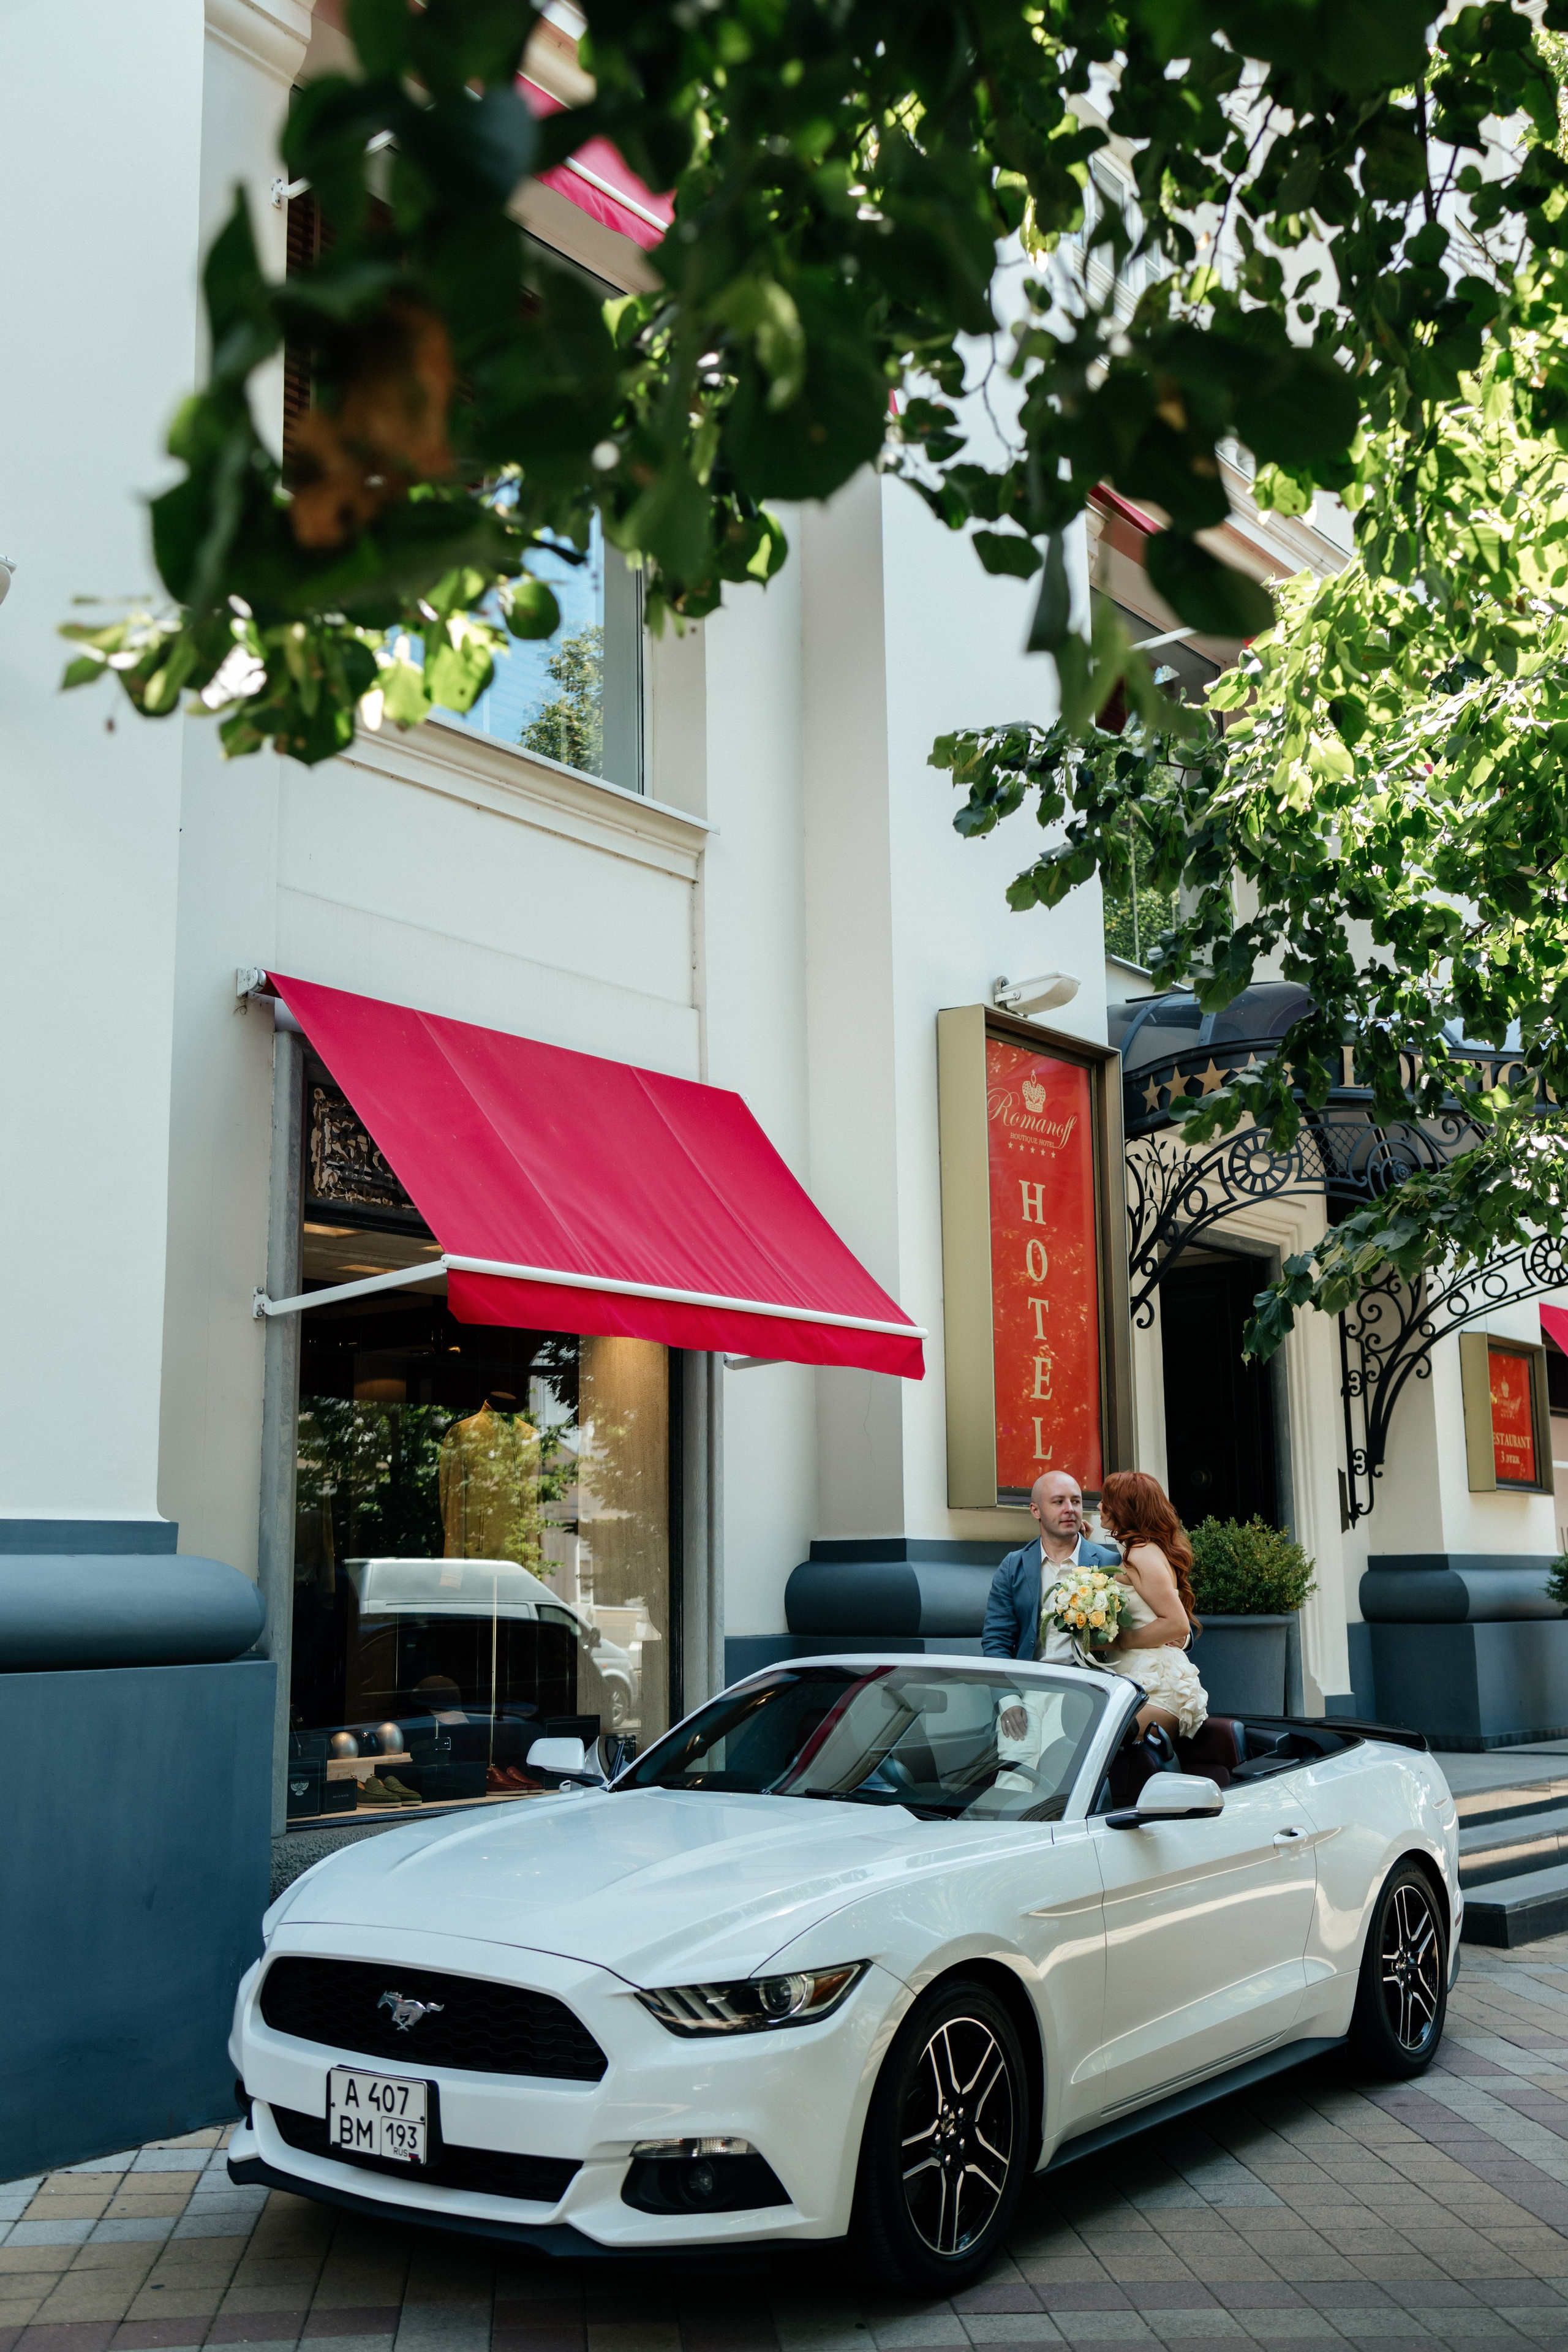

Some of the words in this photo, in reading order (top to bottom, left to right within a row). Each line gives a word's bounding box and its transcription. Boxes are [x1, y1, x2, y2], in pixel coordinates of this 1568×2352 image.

[987, 1088, 1077, 1149] Romanoff
[1010, 1133, 1038, 1144] BOUTIQUE
[1039, 1139, 1056, 1148] HOTEL
[1019, 1180, 1053, 1461] HOTEL
[1493, 1432, 1531, 1449] ESTAURANT
[1501, 1450, 1505, 1464] 3
[345, 2078, 360, 2108] A
[368, 2082, 409, 2116] 407
[340, 2114, 373, 2149] BM
[386, 2122, 417, 2149] 193
[393, 2147, 408, 2158] RUS
